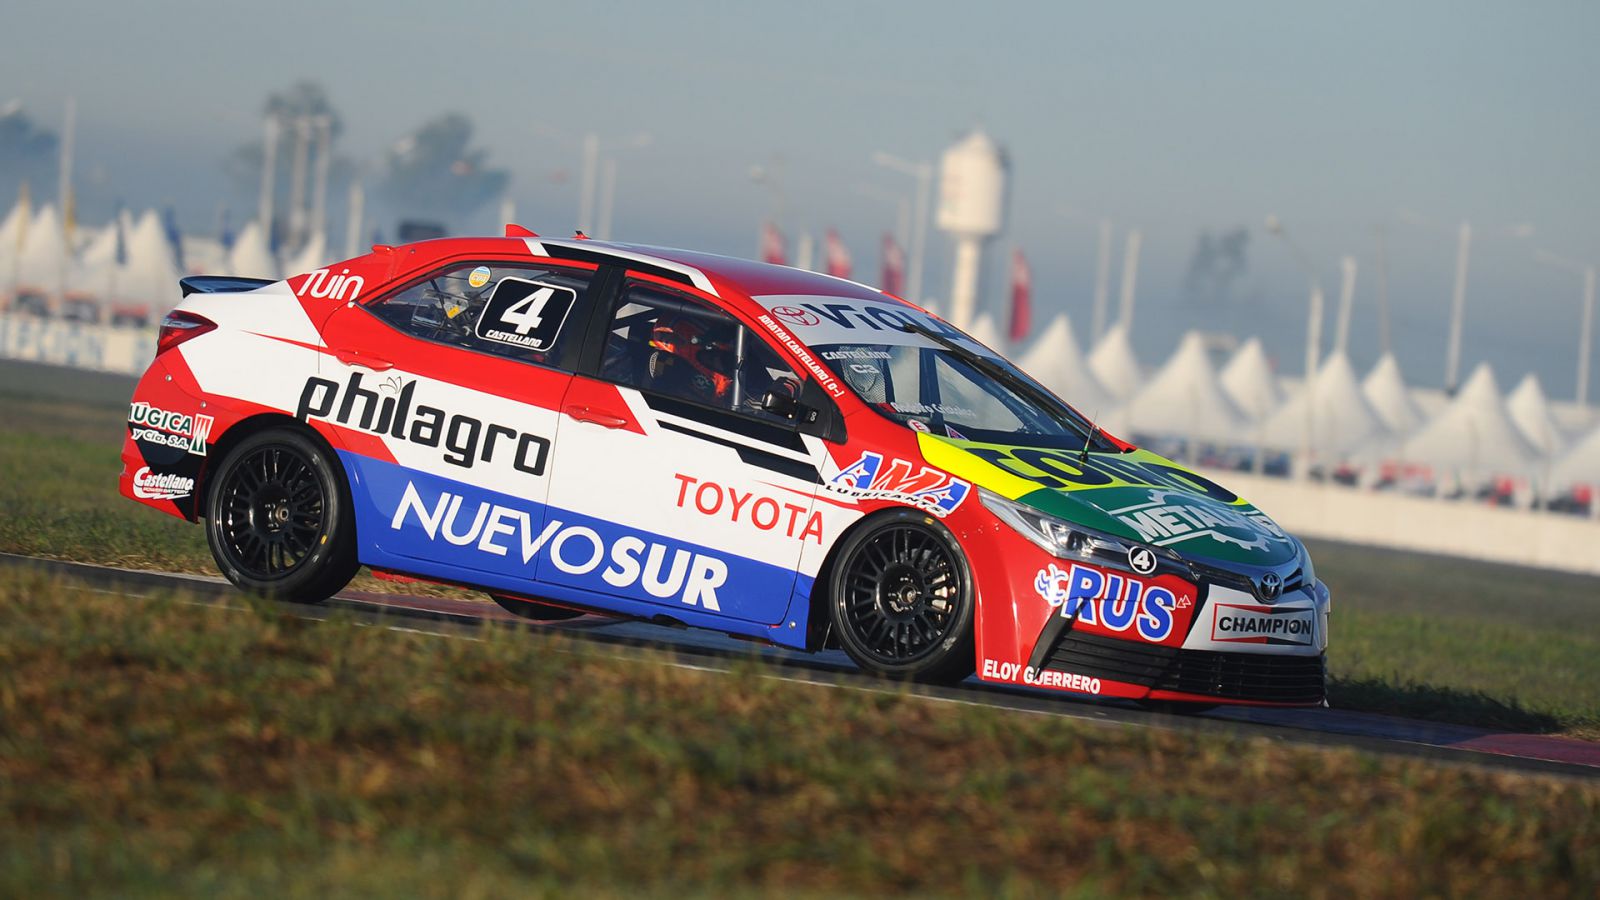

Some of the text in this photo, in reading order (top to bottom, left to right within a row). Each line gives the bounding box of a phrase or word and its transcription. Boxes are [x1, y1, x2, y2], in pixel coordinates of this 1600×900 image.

[499, 286, 555, 335] 4
[485, 329, 543, 348] CASTELLANO
[757, 314, 791, 343] JONATAN
[785, 340, 829, 381] CASTELLANO
[821, 350, 892, 360] CASTELLANO
[294, 371, 552, 477] philagro
[134, 466, 195, 492] Castellano
[673, 473, 824, 545] TOYOTA
[1132, 550, 1151, 570] 4
[1060, 564, 1175, 641] RUS
[1218, 616, 1312, 635] CHAMPION
[983, 658, 1021, 682] ELOY
